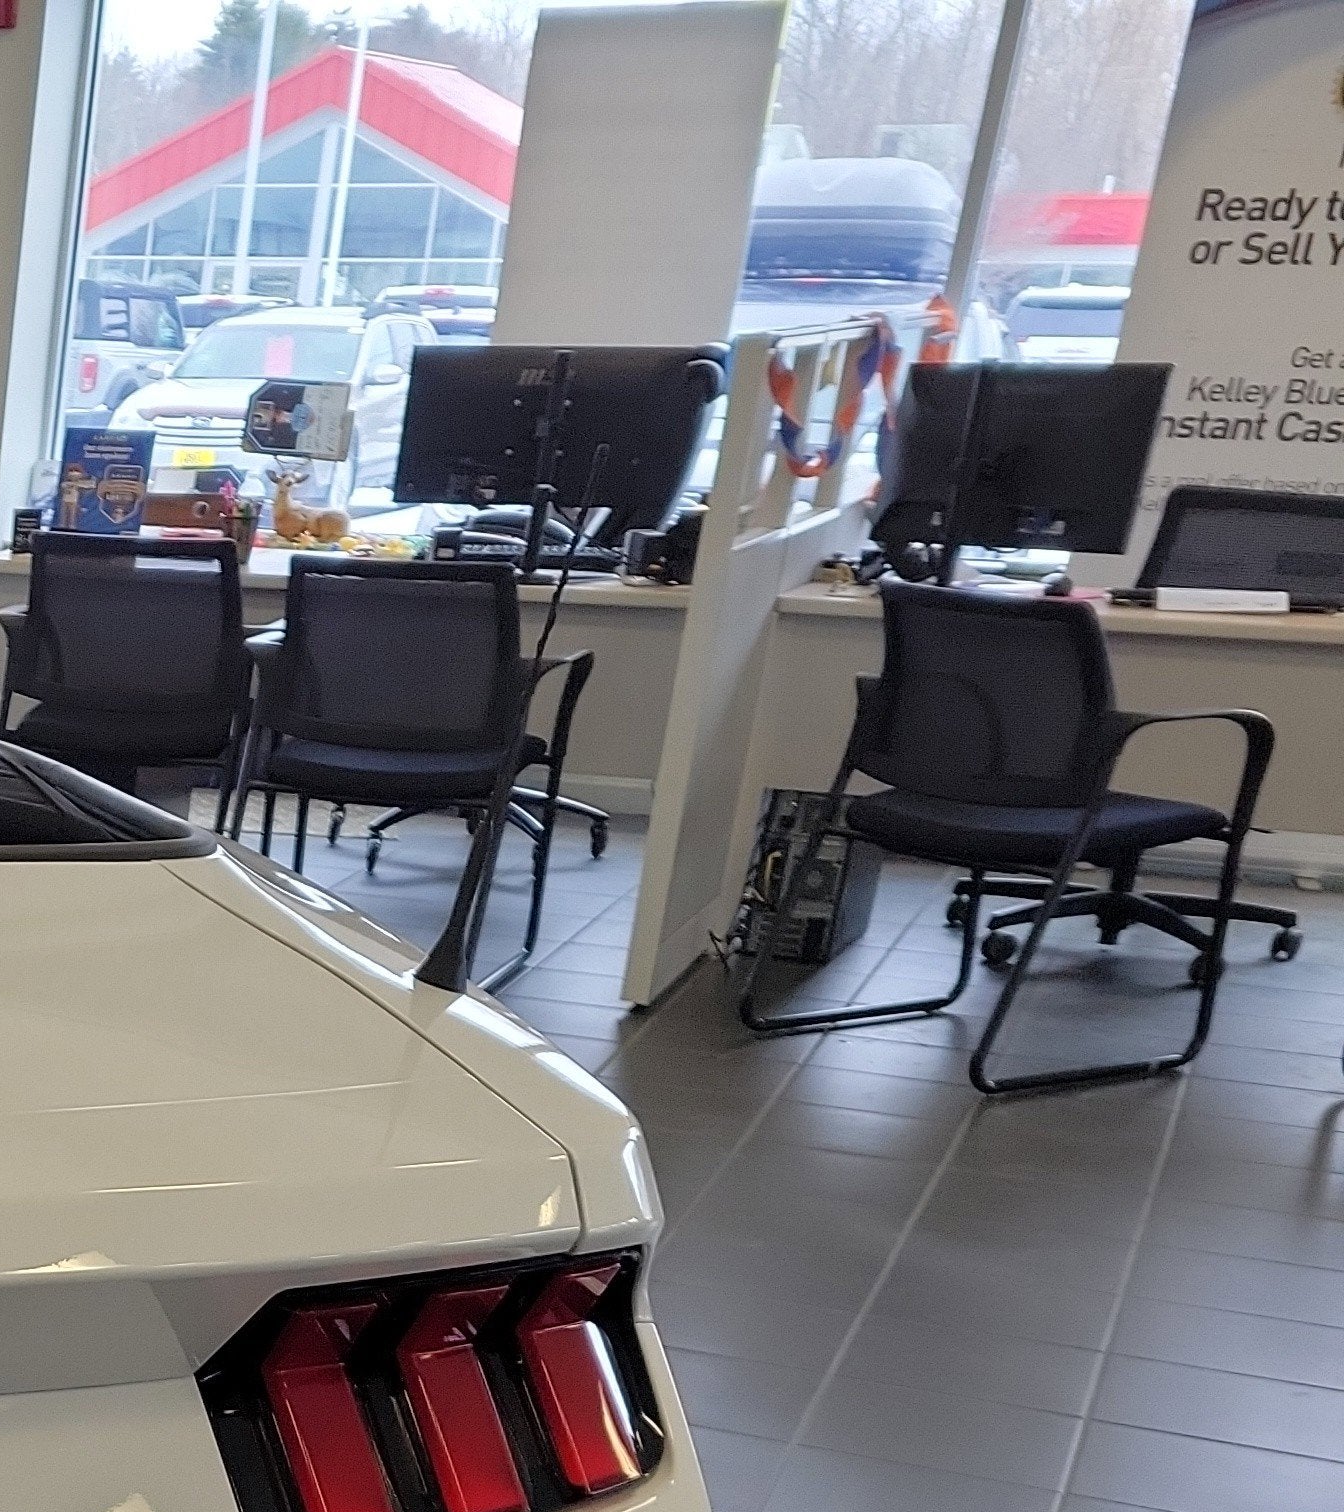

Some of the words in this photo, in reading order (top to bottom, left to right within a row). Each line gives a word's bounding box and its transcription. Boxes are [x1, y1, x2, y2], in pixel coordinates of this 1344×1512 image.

[1195, 187, 1319, 230] Ready
[1326, 190, 1344, 221] t
[1189, 240, 1234, 264] or
[1237, 231, 1315, 265] Sell
[1291, 346, 1334, 368] Get
[1187, 376, 1280, 409] Kelley
[1284, 379, 1344, 405] Blue
